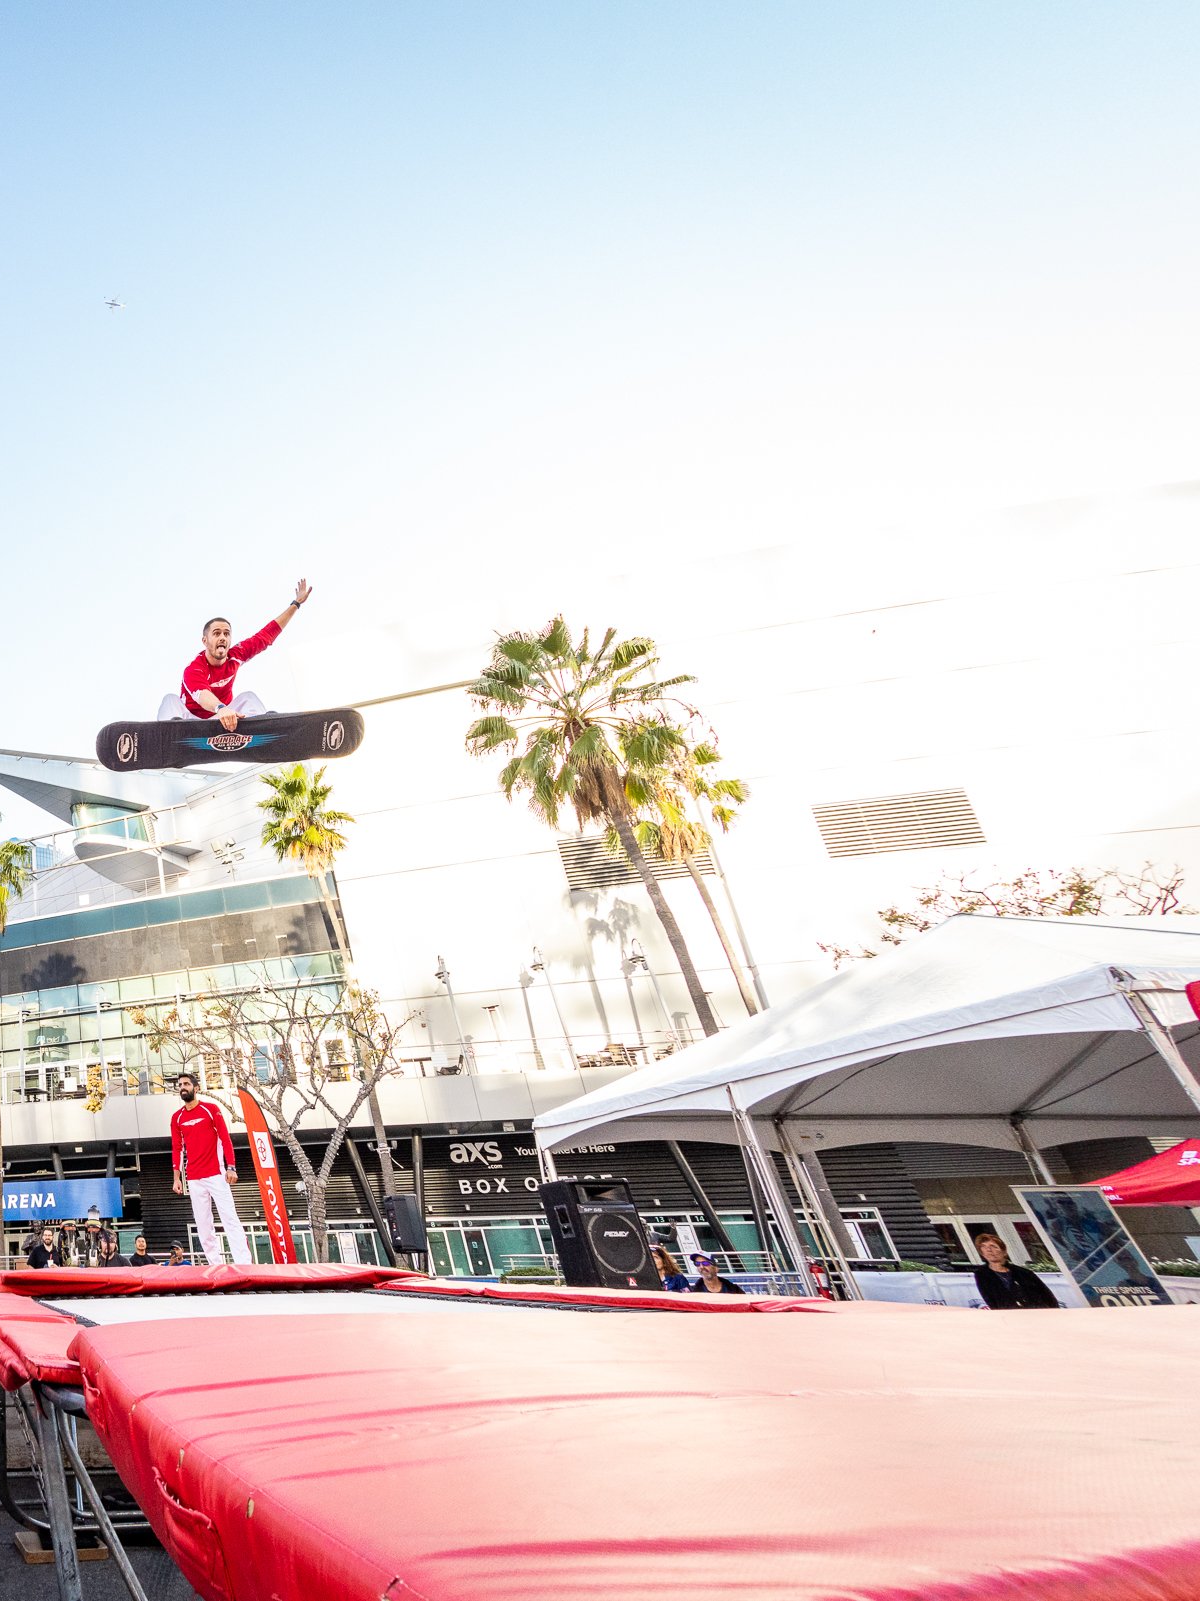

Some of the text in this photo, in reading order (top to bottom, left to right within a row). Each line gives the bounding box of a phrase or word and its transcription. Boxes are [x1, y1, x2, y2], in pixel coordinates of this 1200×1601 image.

[588, 1145, 615, 1153] Here
[458, 1177, 510, 1195] BOX
[1092, 1286, 1119, 1294] THREE
